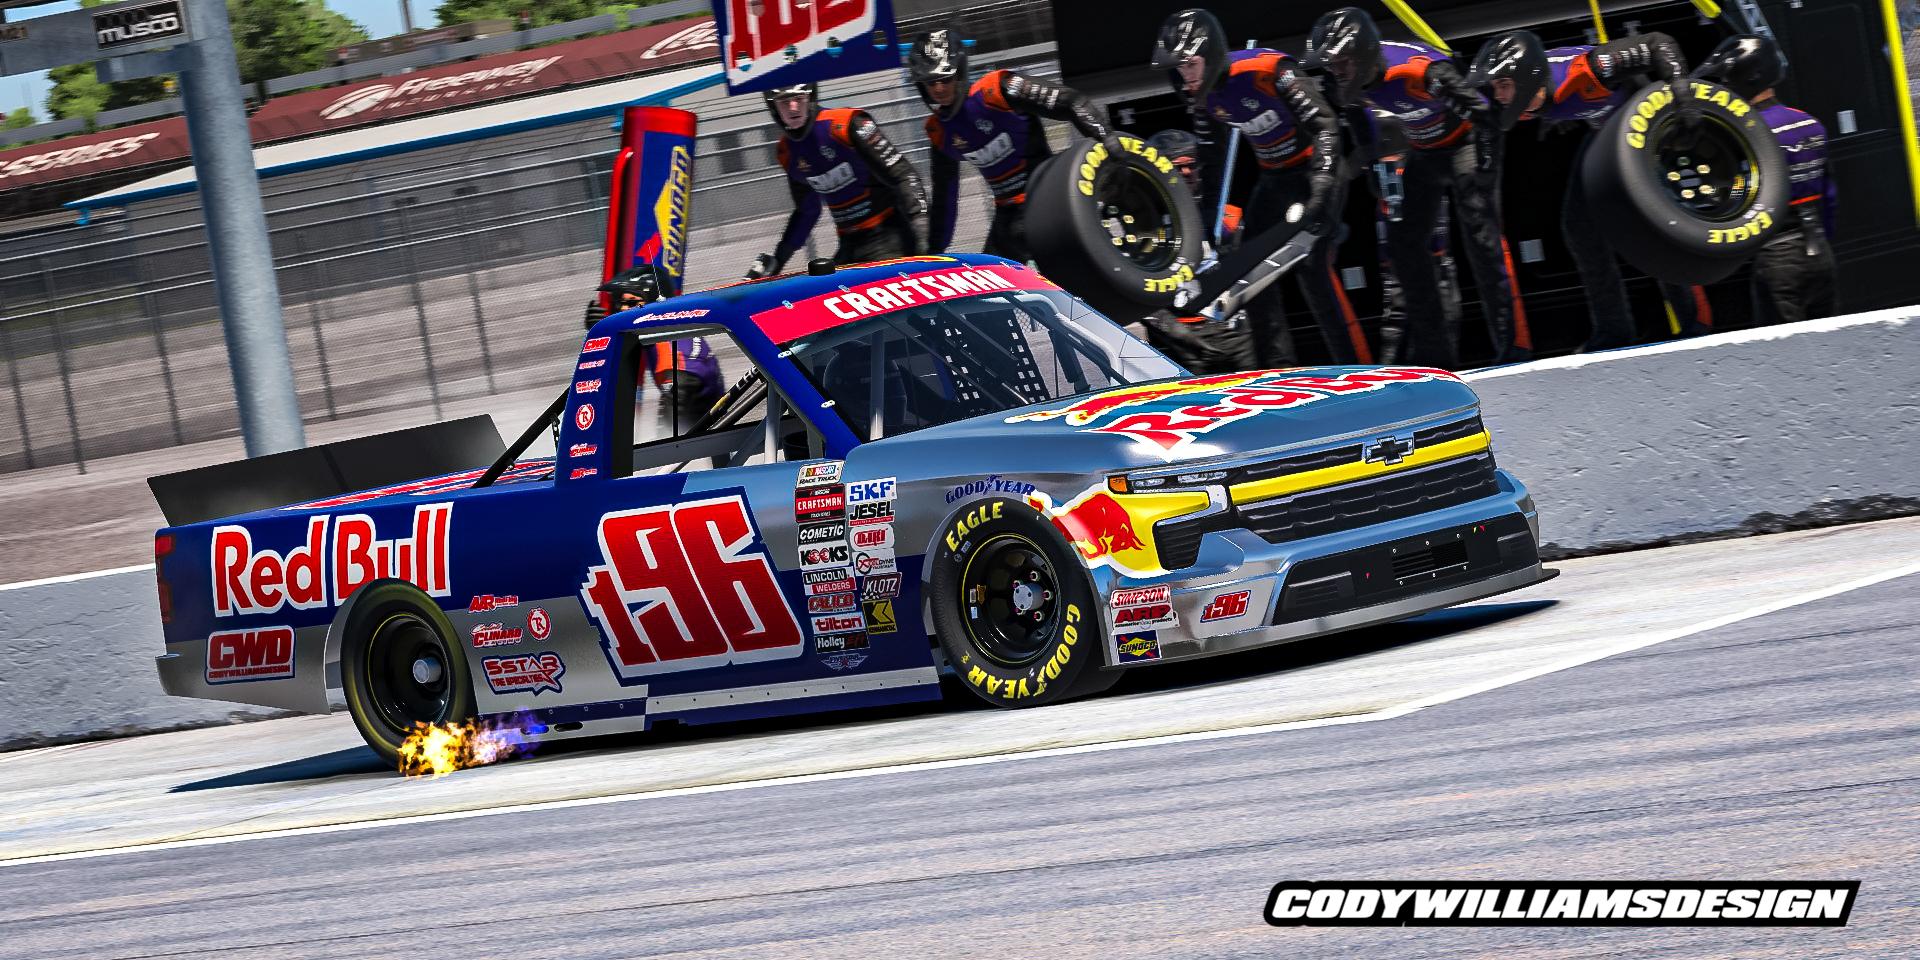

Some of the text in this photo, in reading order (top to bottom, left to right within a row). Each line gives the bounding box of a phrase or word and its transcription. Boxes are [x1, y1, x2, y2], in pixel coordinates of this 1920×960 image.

[98, 17, 179, 43] musco
[662, 145, 691, 276] SUNOCO
[1707, 211, 1773, 243] EAGLE
[823, 269, 1016, 320] CRAFTSMAN
[850, 481, 894, 501] SKF
[797, 497, 842, 511] CRAFTSMAN
[850, 501, 894, 520] JESEL
[800, 525, 843, 540] COMETIC
[946, 502, 1004, 552] EAGLE
[213, 502, 454, 614] Red Bull
[800, 546, 848, 566] KOOKS
[587, 500, 803, 667] 196
[805, 570, 845, 583] LINCOLN
[866, 578, 898, 593] KLOTZ
[815, 581, 851, 592] WELDERS
[1115, 588, 1166, 606] SIMPSON
[815, 617, 862, 631] tilton
[1115, 605, 1171, 624] ARP
[209, 629, 292, 670] CWD
[817, 636, 845, 649] Holley
[1119, 641, 1157, 653] SUNOCO
